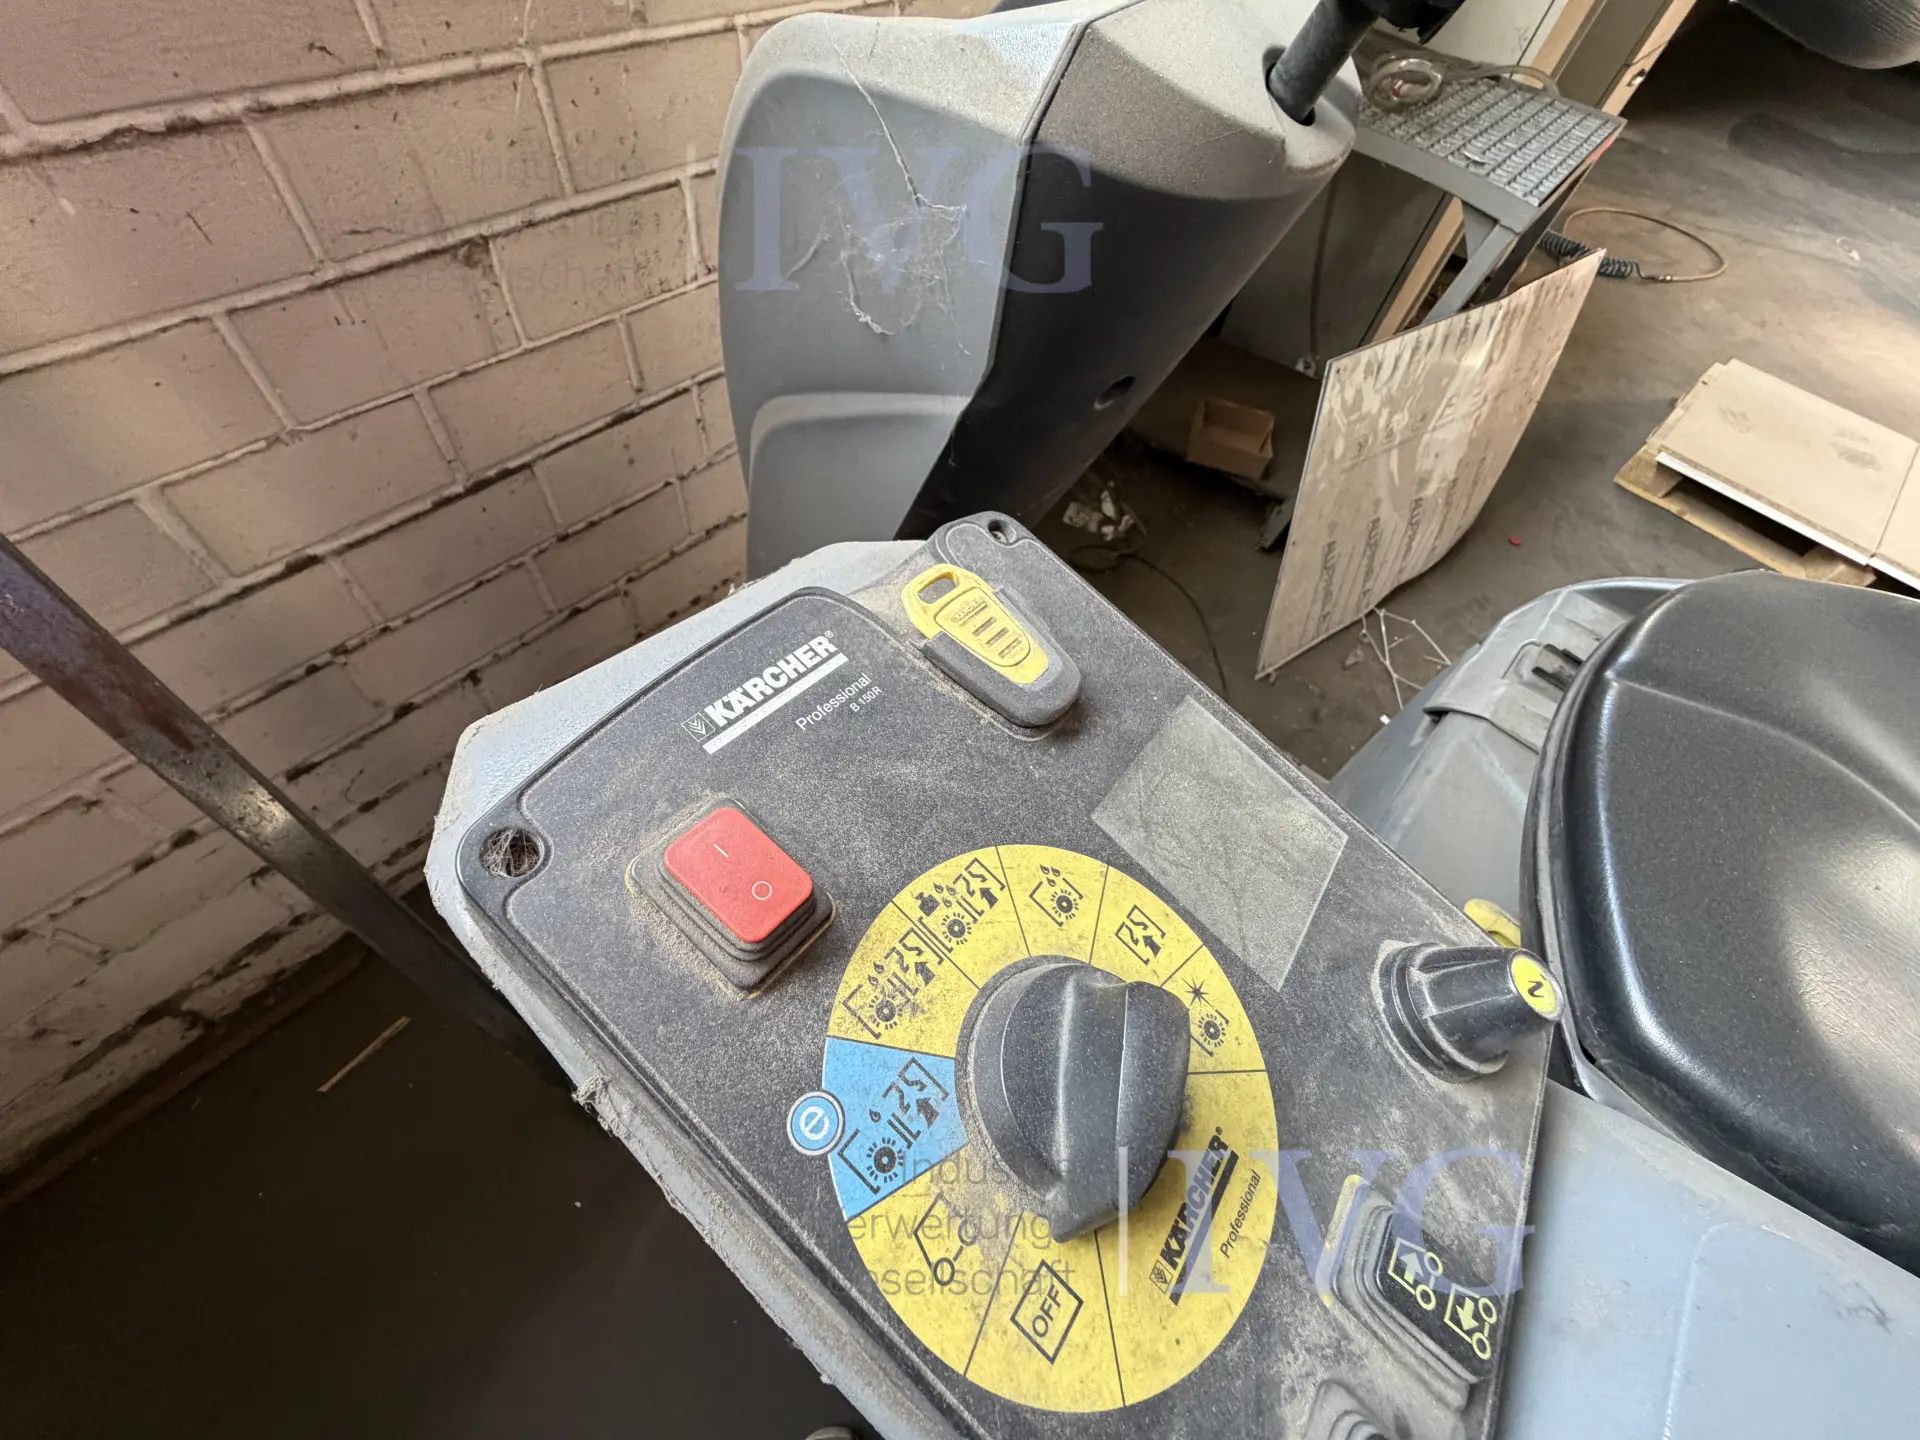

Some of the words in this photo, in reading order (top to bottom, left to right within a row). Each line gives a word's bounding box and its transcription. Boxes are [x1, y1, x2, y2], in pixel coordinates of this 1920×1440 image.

[795, 672, 872, 731] Professional
[849, 702, 860, 713] B
[1219, 1169, 1262, 1259] Professional
[1032, 1284, 1061, 1338] OFF
